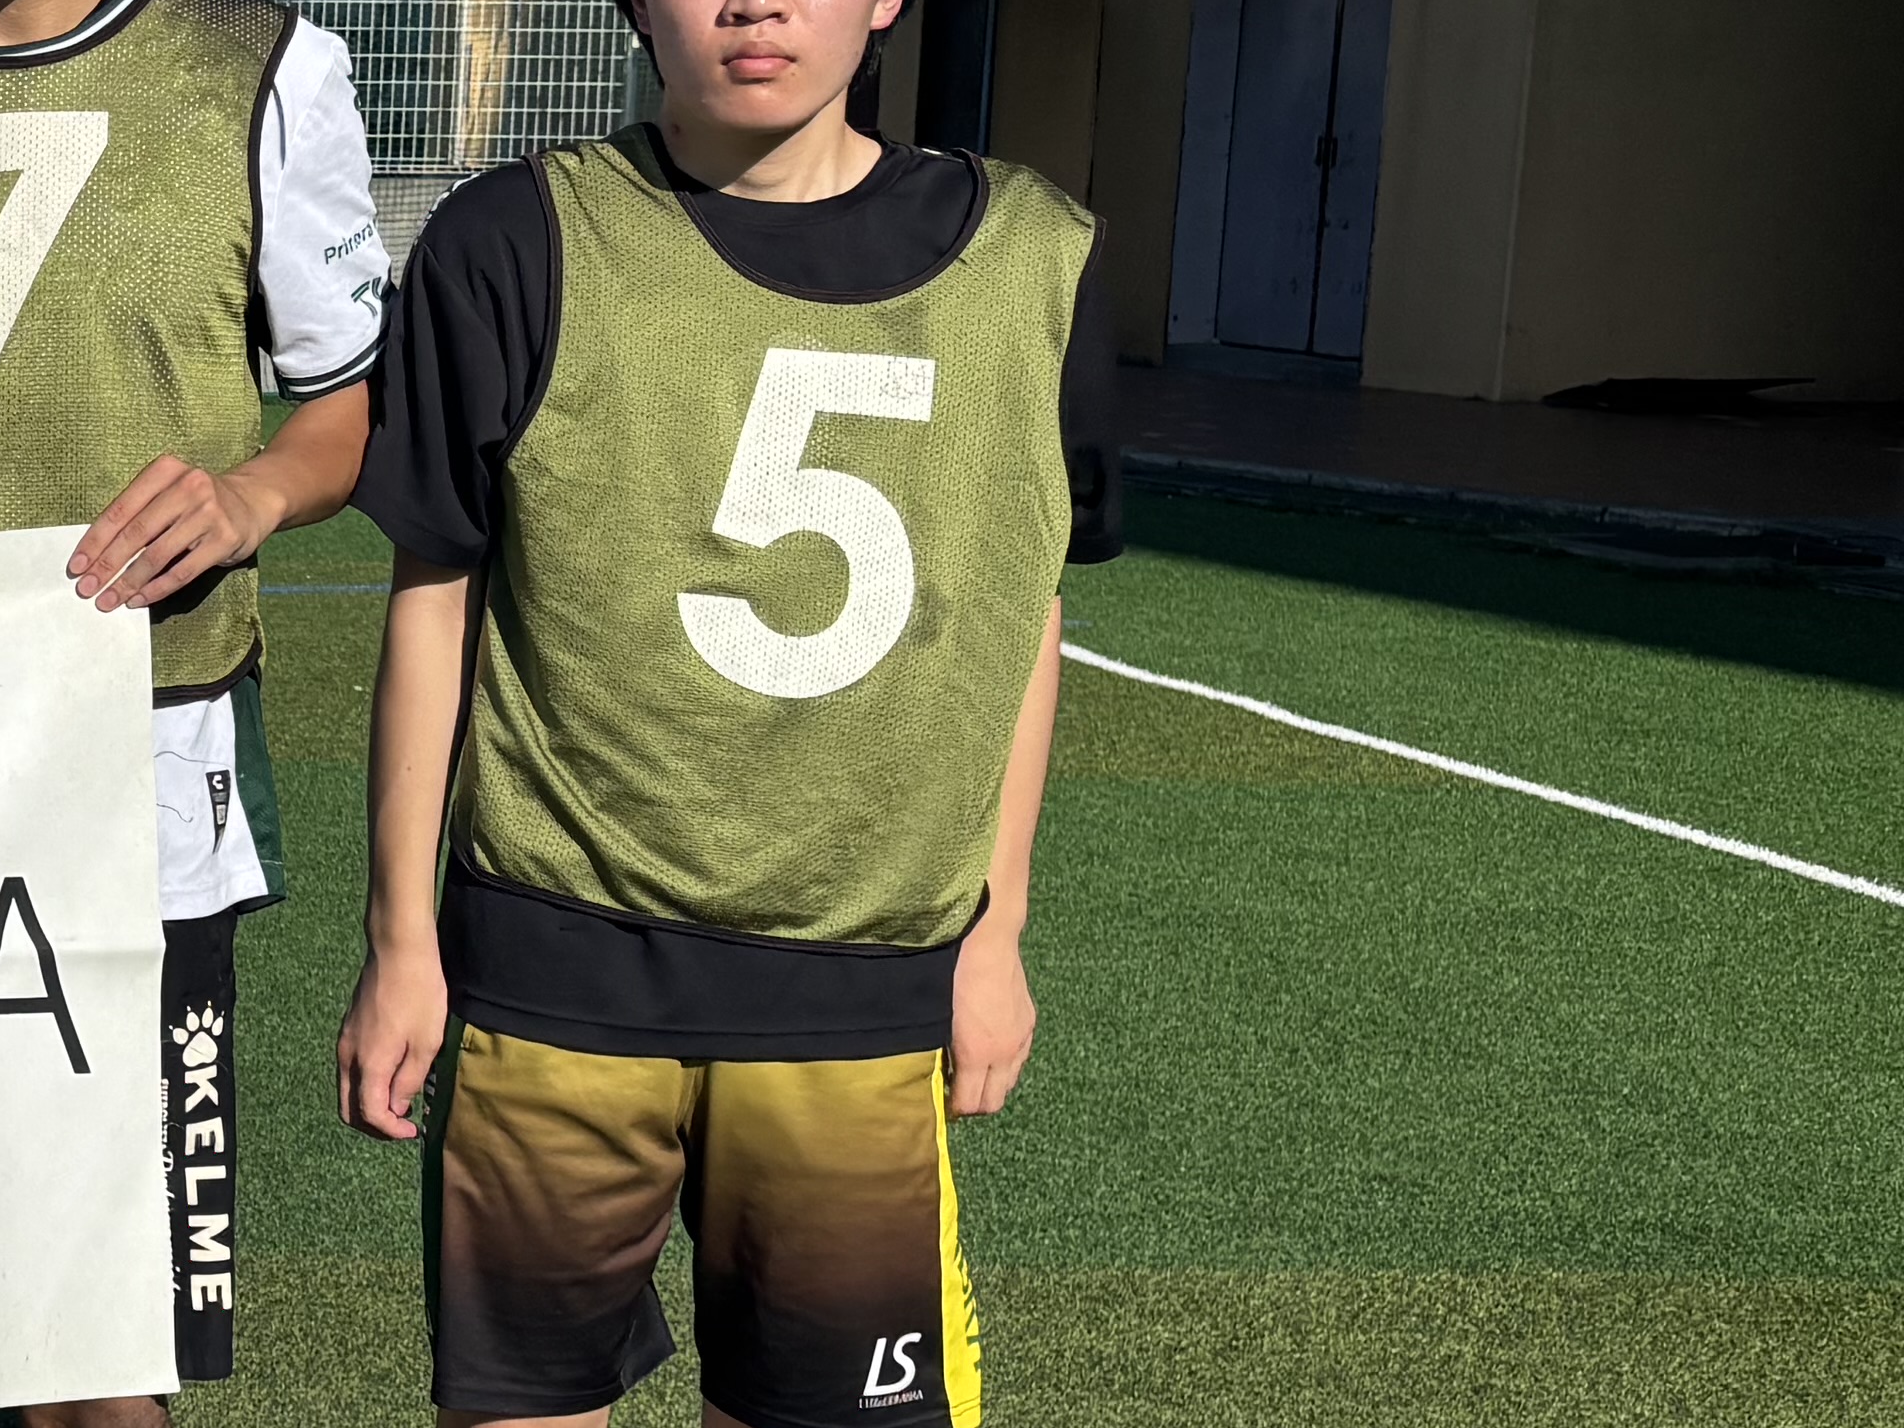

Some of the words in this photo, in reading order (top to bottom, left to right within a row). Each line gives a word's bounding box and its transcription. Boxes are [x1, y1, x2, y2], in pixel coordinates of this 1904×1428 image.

[676, 347, 936, 699] 5
[184, 1064, 233, 1311] KELME
[863, 1332, 922, 1396] LS
